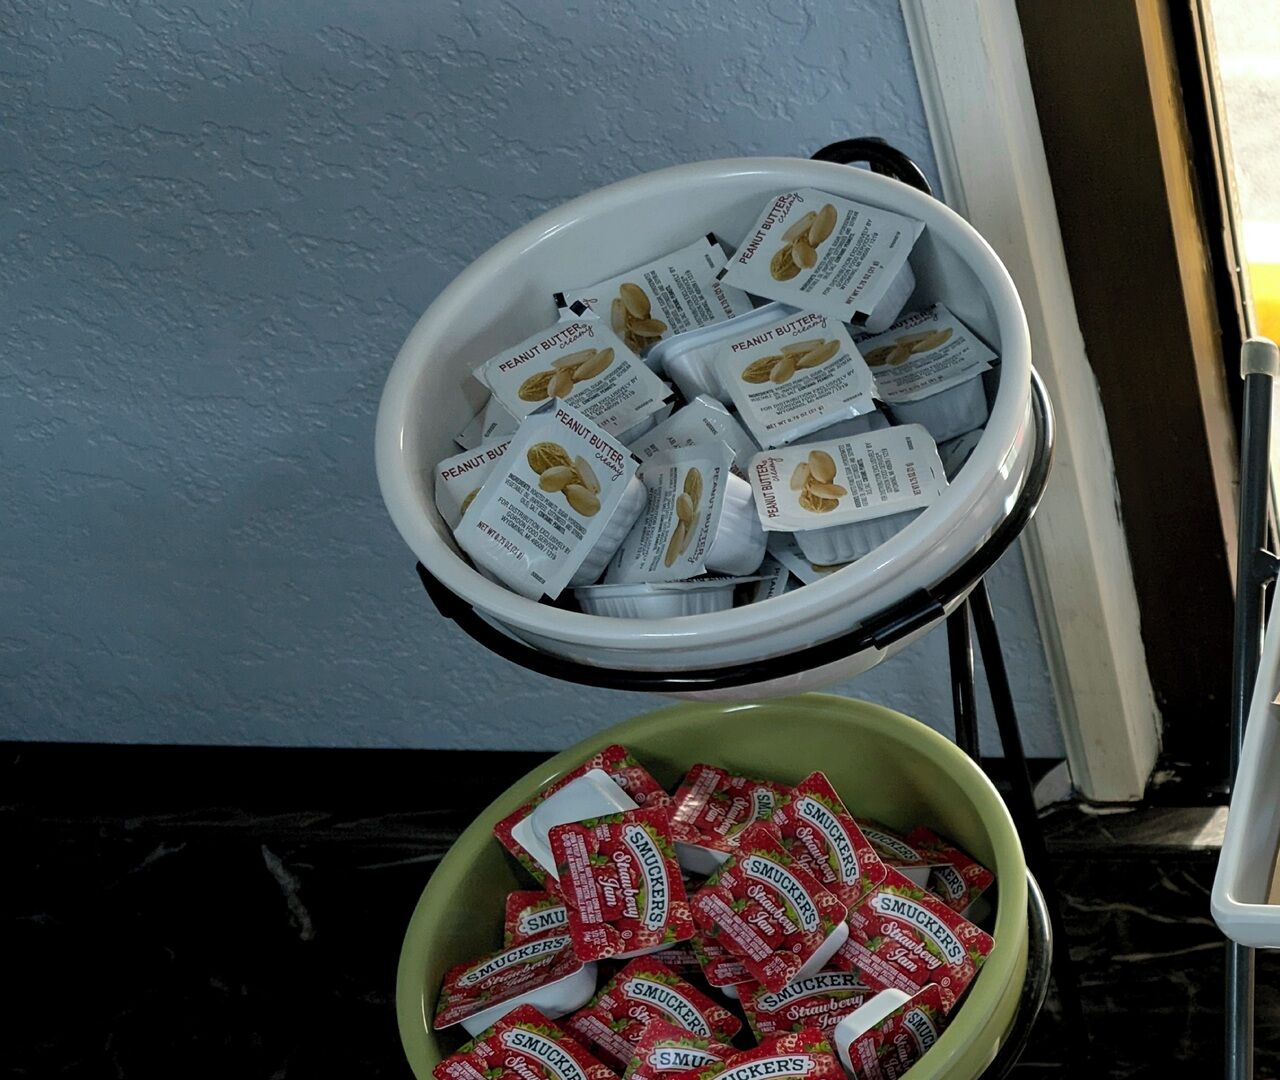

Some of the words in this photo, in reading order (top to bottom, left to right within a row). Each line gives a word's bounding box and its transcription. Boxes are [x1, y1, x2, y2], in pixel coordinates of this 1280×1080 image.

[778, 192, 804, 223] creamy
[738, 228, 766, 265] PEANUT
[761, 194, 789, 231] BUTTER
[559, 323, 595, 350] creamy
[732, 331, 773, 353] PEANUT
[776, 314, 818, 336] BUTTER
[793, 316, 827, 337] creamy
[499, 344, 540, 373] PEANUT
[540, 321, 582, 350] BUTTER
[554, 408, 591, 440] PEANUT
[588, 434, 625, 465] BUTTER
[442, 456, 485, 480] PEANUT
[594, 451, 624, 482] creamy
[755, 462, 772, 490] BUTTER
[767, 455, 785, 482] creamy
[764, 491, 779, 518] PEANUT
[476, 520, 489, 532] NET
[486, 527, 497, 538] WT
[505, 510, 526, 528] GORDON
[524, 525, 539, 537] FOOD
[507, 503, 539, 530] DISTRIBUTION
[538, 526, 566, 550] EXCLUSIVELY
[796, 826, 838, 883] Strawberry
[804, 801, 857, 878] SMUCKER'S
[599, 872, 621, 907] Jam
[612, 851, 640, 918] Strawberry
[630, 831, 665, 924] SMUCKER'S
[751, 860, 816, 928] SMUCKER'S
[748, 884, 798, 935] Strawberry
[749, 910, 775, 937] Jam
[880, 899, 961, 962] SMUCKER'S
[880, 922, 942, 970] Strawberry
[466, 937, 566, 983] SMUCKER'S
[481, 955, 555, 990] Strawberry
[893, 947, 918, 972] Jam
[632, 982, 707, 1038] SMUCKER'S
[764, 973, 866, 1010] SMUCKER
[787, 994, 864, 1020] Strawberry
